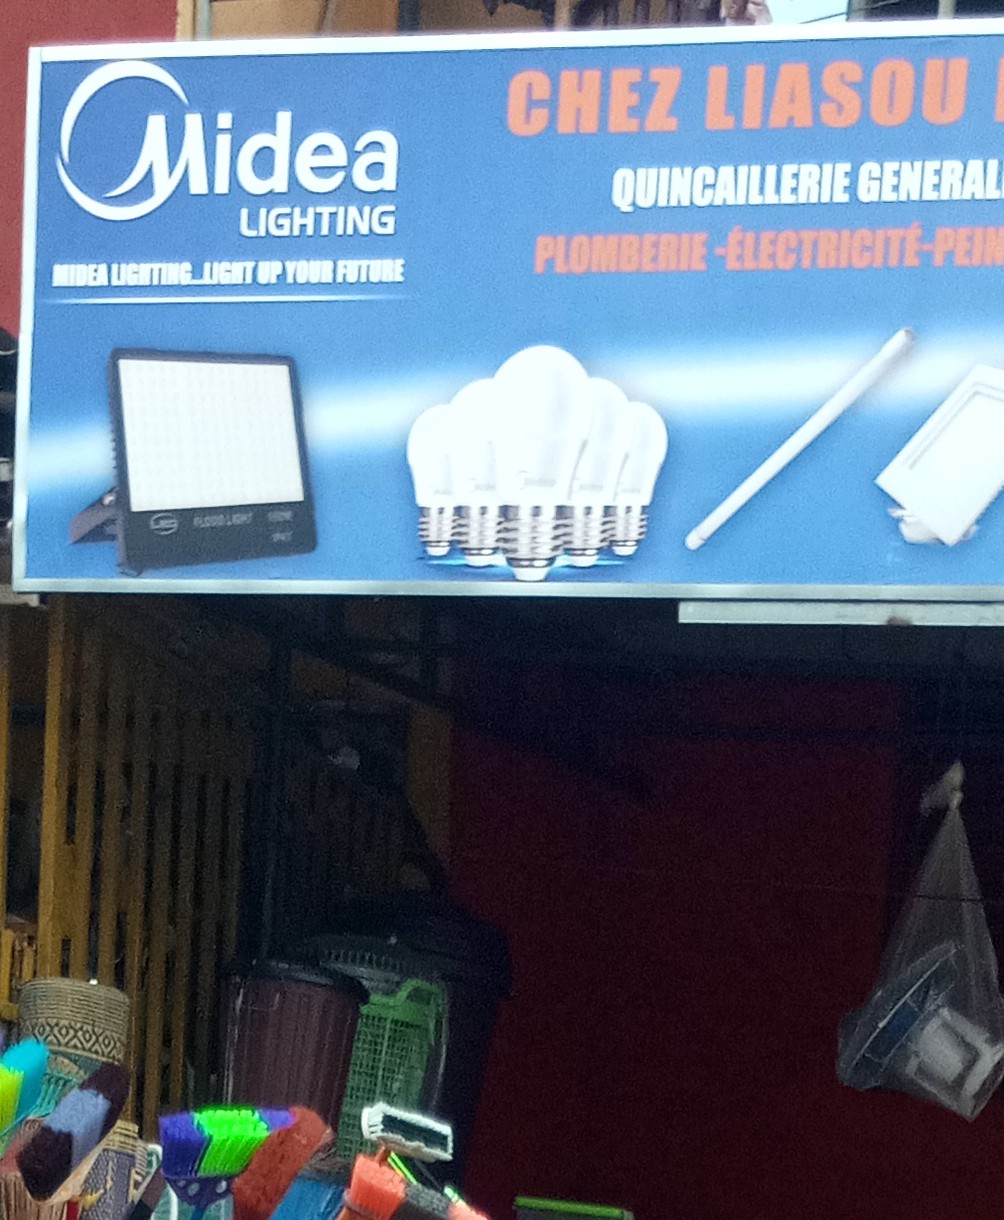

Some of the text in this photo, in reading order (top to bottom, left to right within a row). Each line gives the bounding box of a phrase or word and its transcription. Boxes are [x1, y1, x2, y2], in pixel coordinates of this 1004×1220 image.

[507, 66, 682, 137] CHEZ
[704, 57, 969, 131] LIASOU
[95, 104, 399, 204] Midea
[612, 161, 851, 212] QUINCAILLERIE
[239, 205, 397, 238] LIGHTING
[52, 262, 109, 287] MIDEA
[257, 261, 284, 285] UP
[284, 260, 335, 284] YOUR
[336, 258, 405, 284] FUTURE
[534, 231, 709, 275] PLOMBERIE
